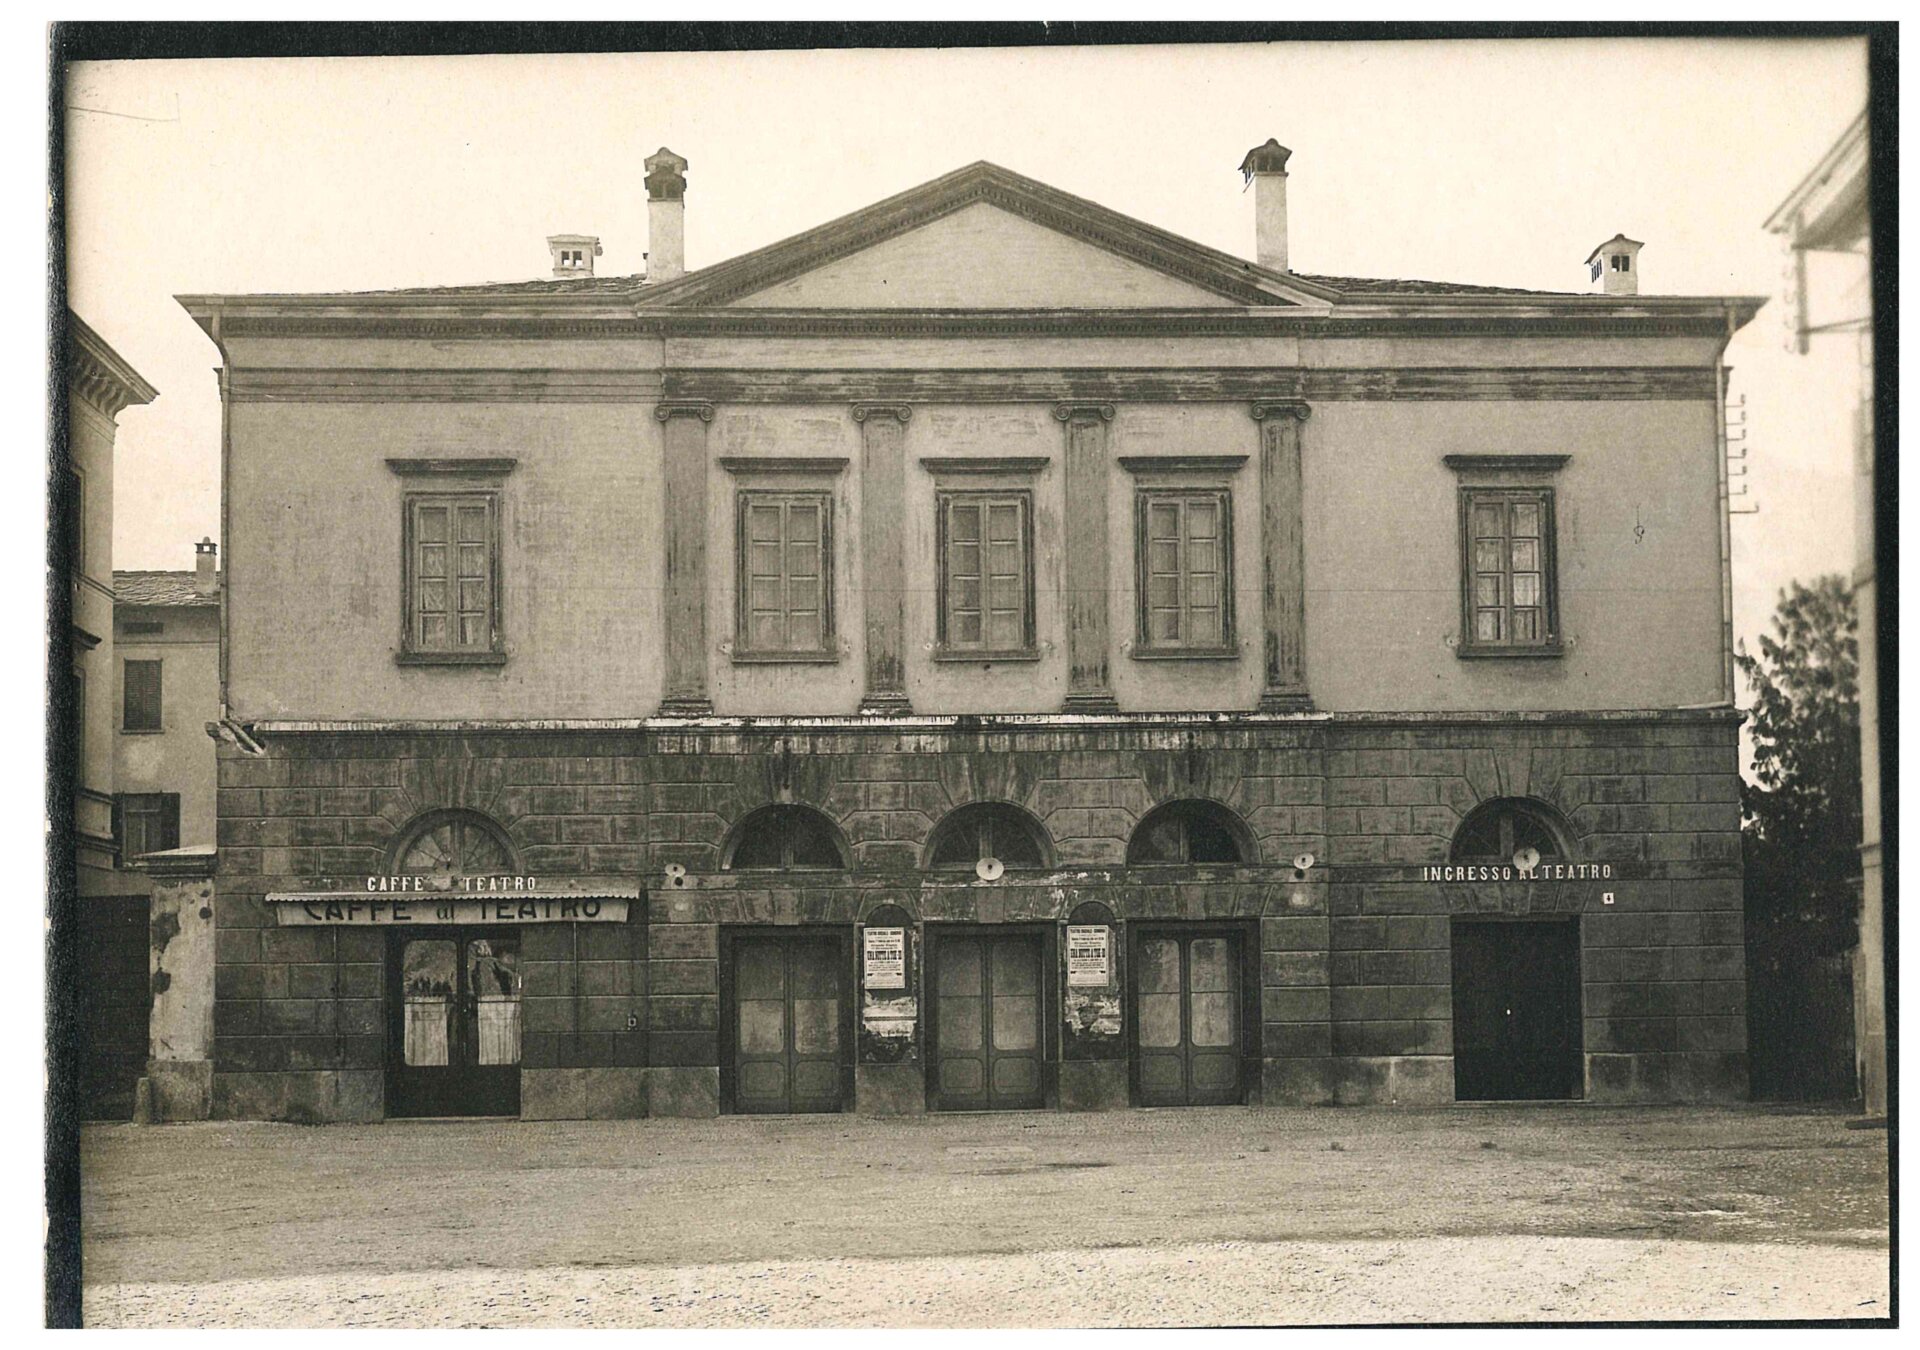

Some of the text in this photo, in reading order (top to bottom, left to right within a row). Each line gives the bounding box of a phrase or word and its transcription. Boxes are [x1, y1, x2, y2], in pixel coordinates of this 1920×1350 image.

[1424, 866, 1511, 881] INGRESSO
[1542, 863, 1611, 879] TEATRO
[463, 876, 536, 891] TEATRO
[305, 901, 411, 920] CAFFE
[482, 899, 602, 919] TEATRO
